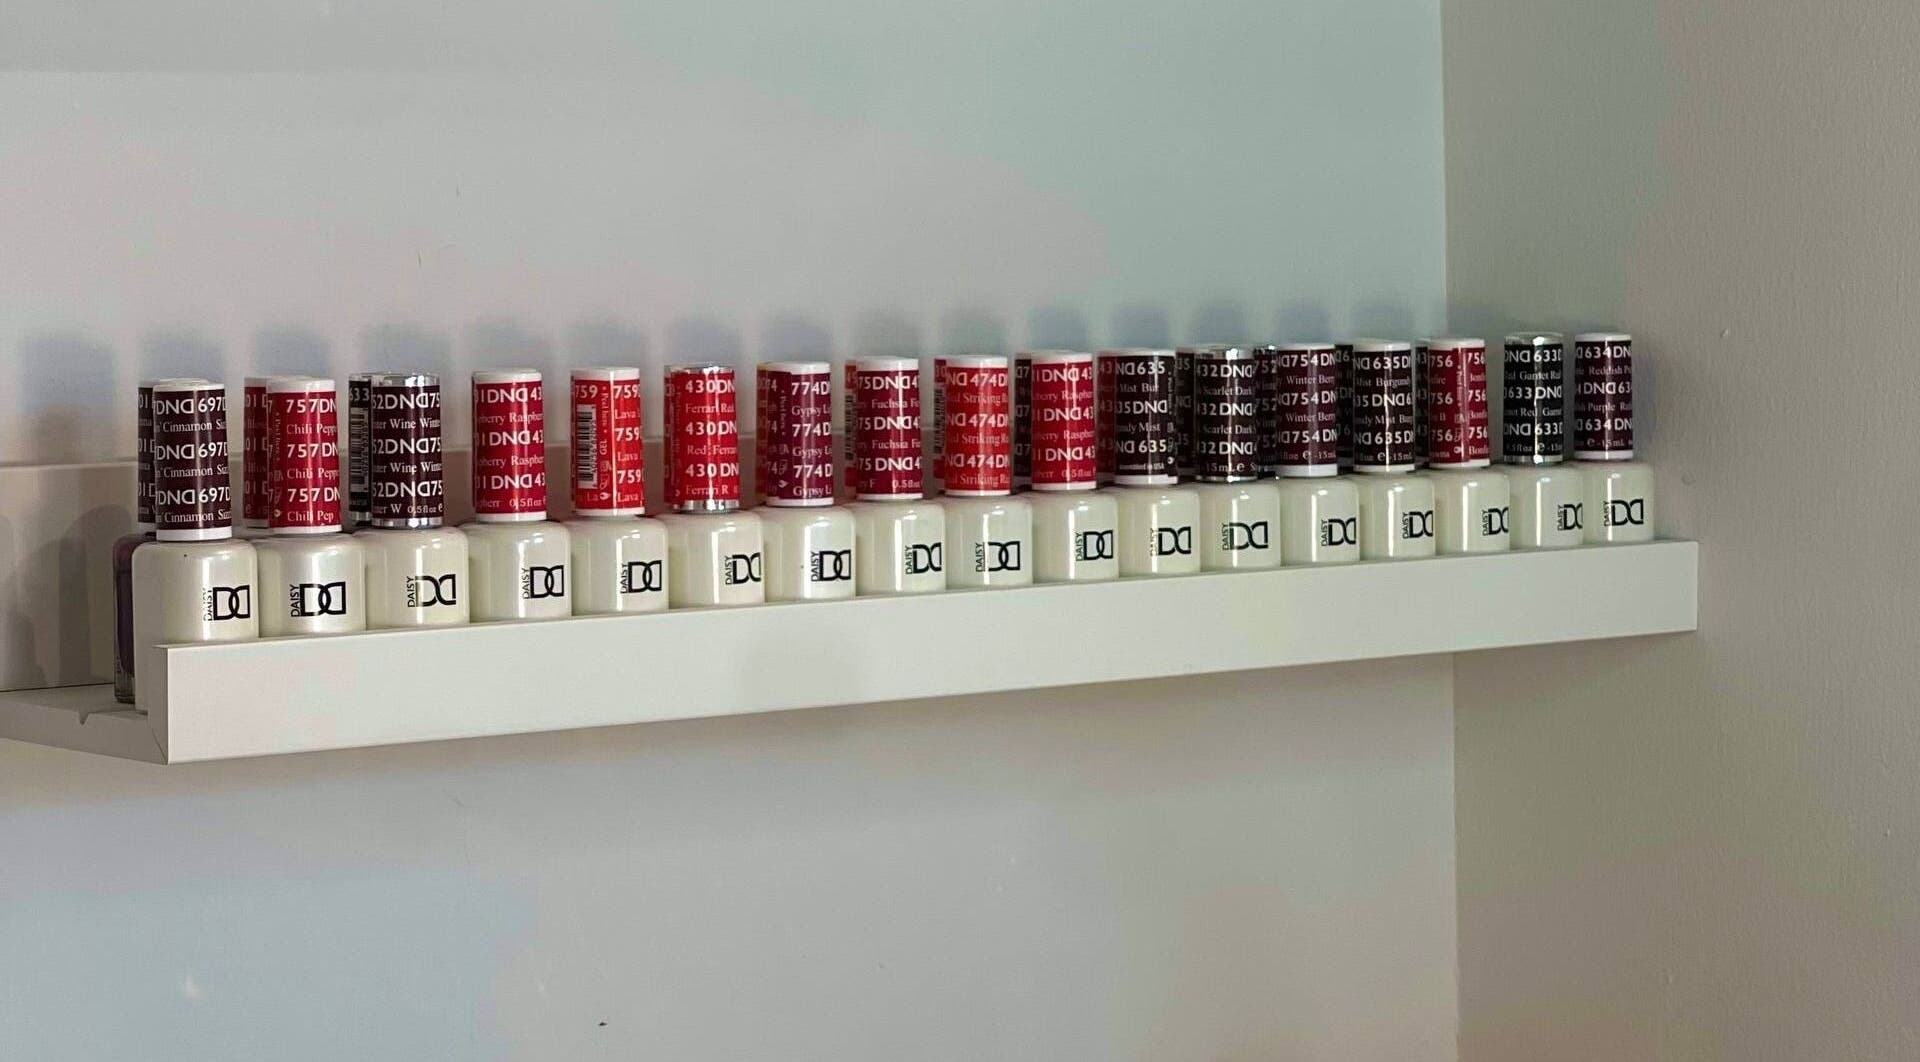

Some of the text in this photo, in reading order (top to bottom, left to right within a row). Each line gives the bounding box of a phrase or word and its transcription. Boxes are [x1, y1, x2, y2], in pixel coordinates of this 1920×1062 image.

[1287, 375, 1316, 385] Winter
[963, 392, 1000, 406] Striking
[792, 405, 821, 417] Gypsy
[1588, 403, 1615, 413] Purple
[615, 409, 635, 420] Lava
[1286, 413, 1316, 422] Winter
[163, 422, 212, 432] Cinnamon
[287, 424, 312, 434] Chili
[390, 419, 416, 429] Wine
[872, 440, 908, 449] Fuchsia
[962, 433, 1000, 446] Striking
[618, 452, 638, 461] Lava
[793, 448, 823, 459] Gypsy
[164, 467, 213, 477] Cinnamon
[287, 468, 312, 479] Chili
[390, 463, 417, 475] Wine
[960, 474, 998, 488] Striking
[618, 492, 638, 502] Lava
[793, 486, 824, 498] Gypsy
[165, 512, 214, 522] Cinnamon
[288, 511, 313, 521] Chili
[976, 543, 986, 572] DAISY
[811, 551, 820, 581] DAISY
[620, 563, 628, 593] DAISY
[291, 585, 300, 617] DAISY
